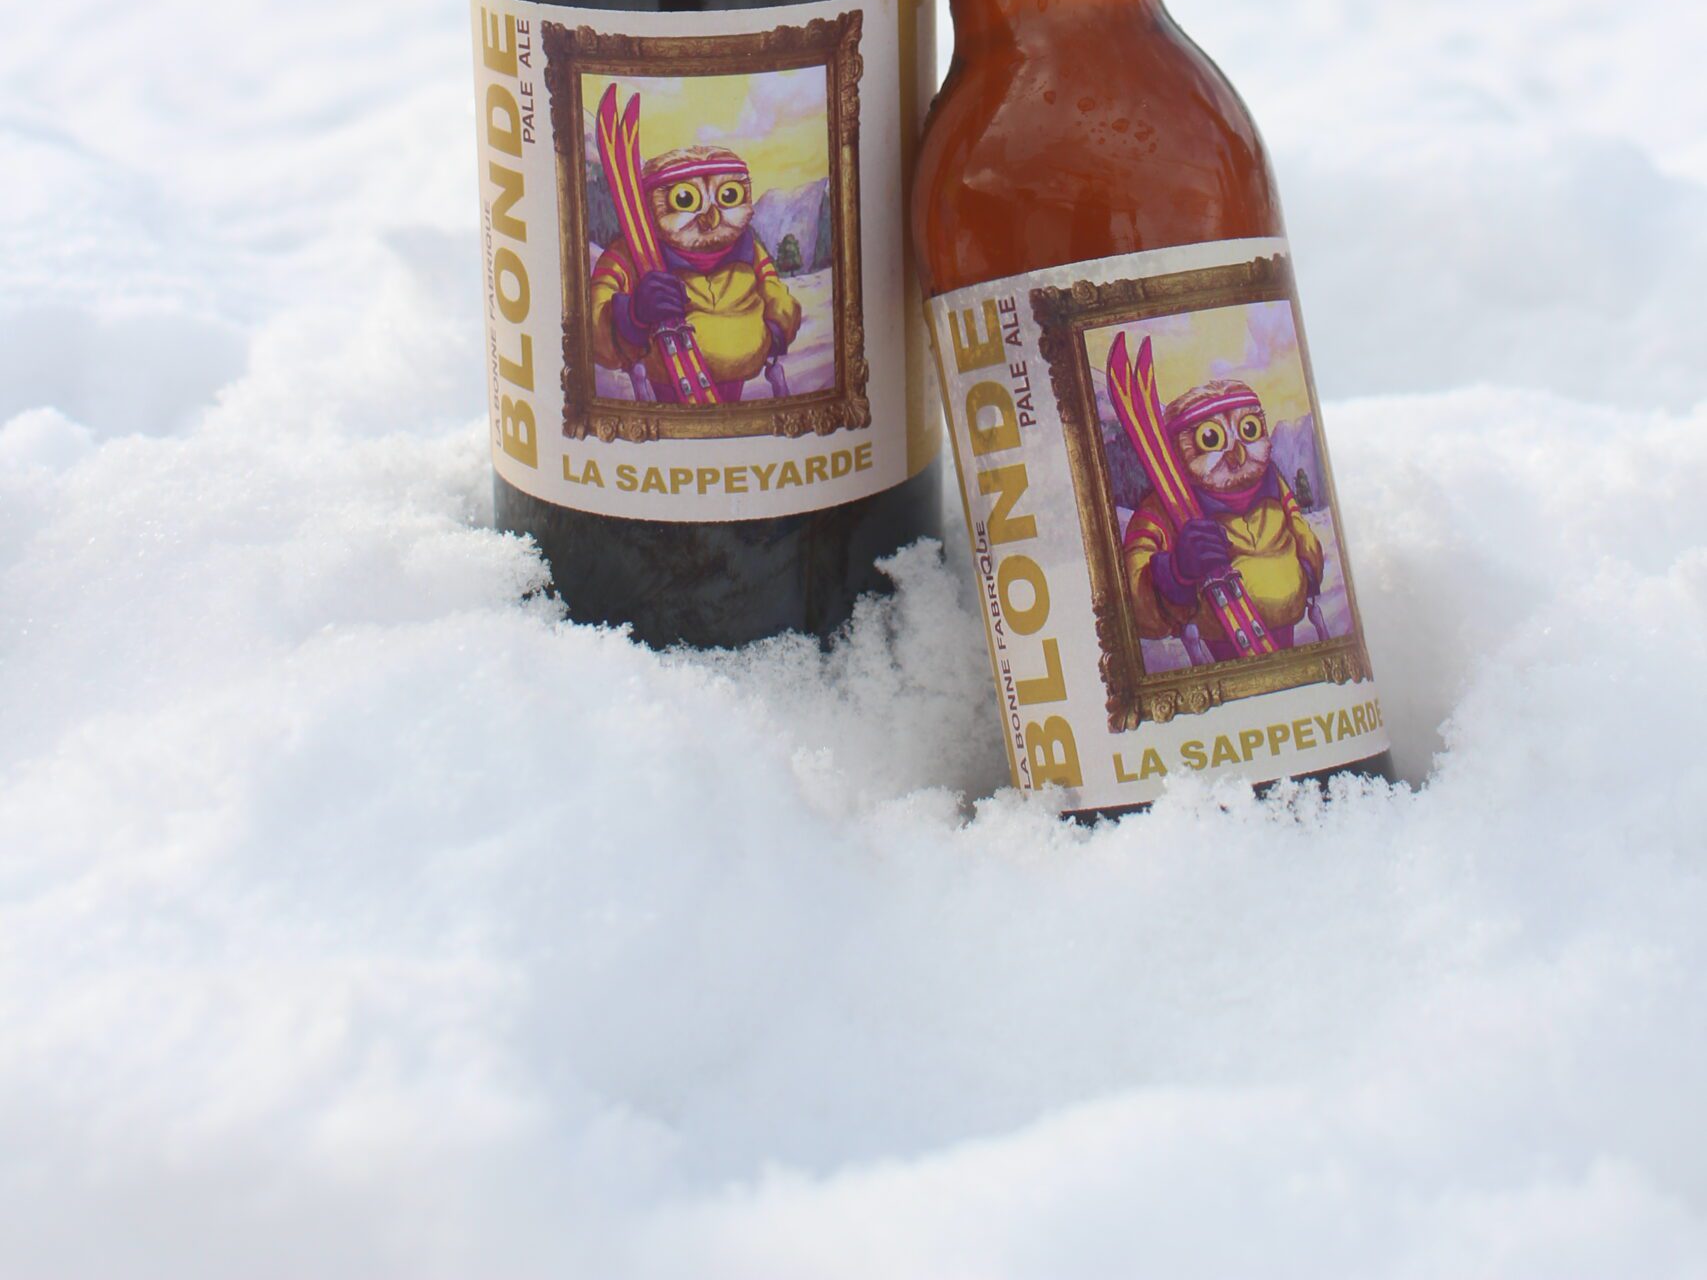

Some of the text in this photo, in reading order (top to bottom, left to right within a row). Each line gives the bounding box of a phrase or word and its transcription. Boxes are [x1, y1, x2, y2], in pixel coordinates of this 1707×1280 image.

[517, 18, 536, 144] PALE ALE
[481, 6, 538, 470] BLONDE
[484, 200, 496, 321] FABRIQUE
[489, 327, 500, 412] BONNE
[998, 296, 1036, 428] PALE ALE
[562, 441, 873, 495] LA SAPPEYARDE
[948, 298, 1084, 791] BLONDE
[976, 521, 1032, 789] LA BONNE FABRIQUE
[1112, 747, 1168, 783] LA
